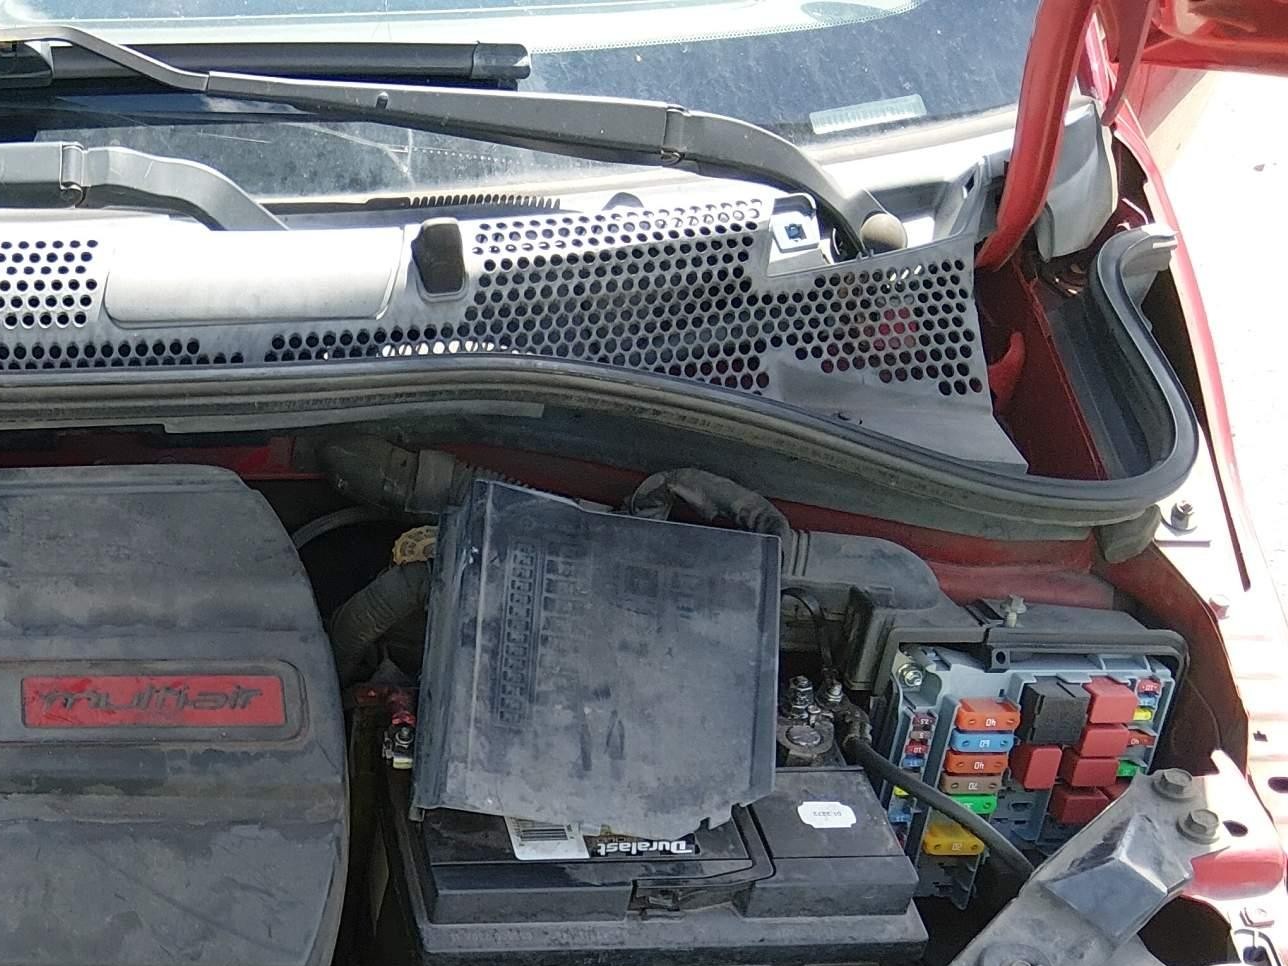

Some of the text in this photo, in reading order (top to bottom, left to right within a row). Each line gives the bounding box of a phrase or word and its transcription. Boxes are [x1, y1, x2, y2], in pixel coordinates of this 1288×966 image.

[38, 684, 263, 712] multiair
[985, 718, 997, 727] 40
[973, 761, 985, 771] 40
[596, 840, 693, 856] Duralast
